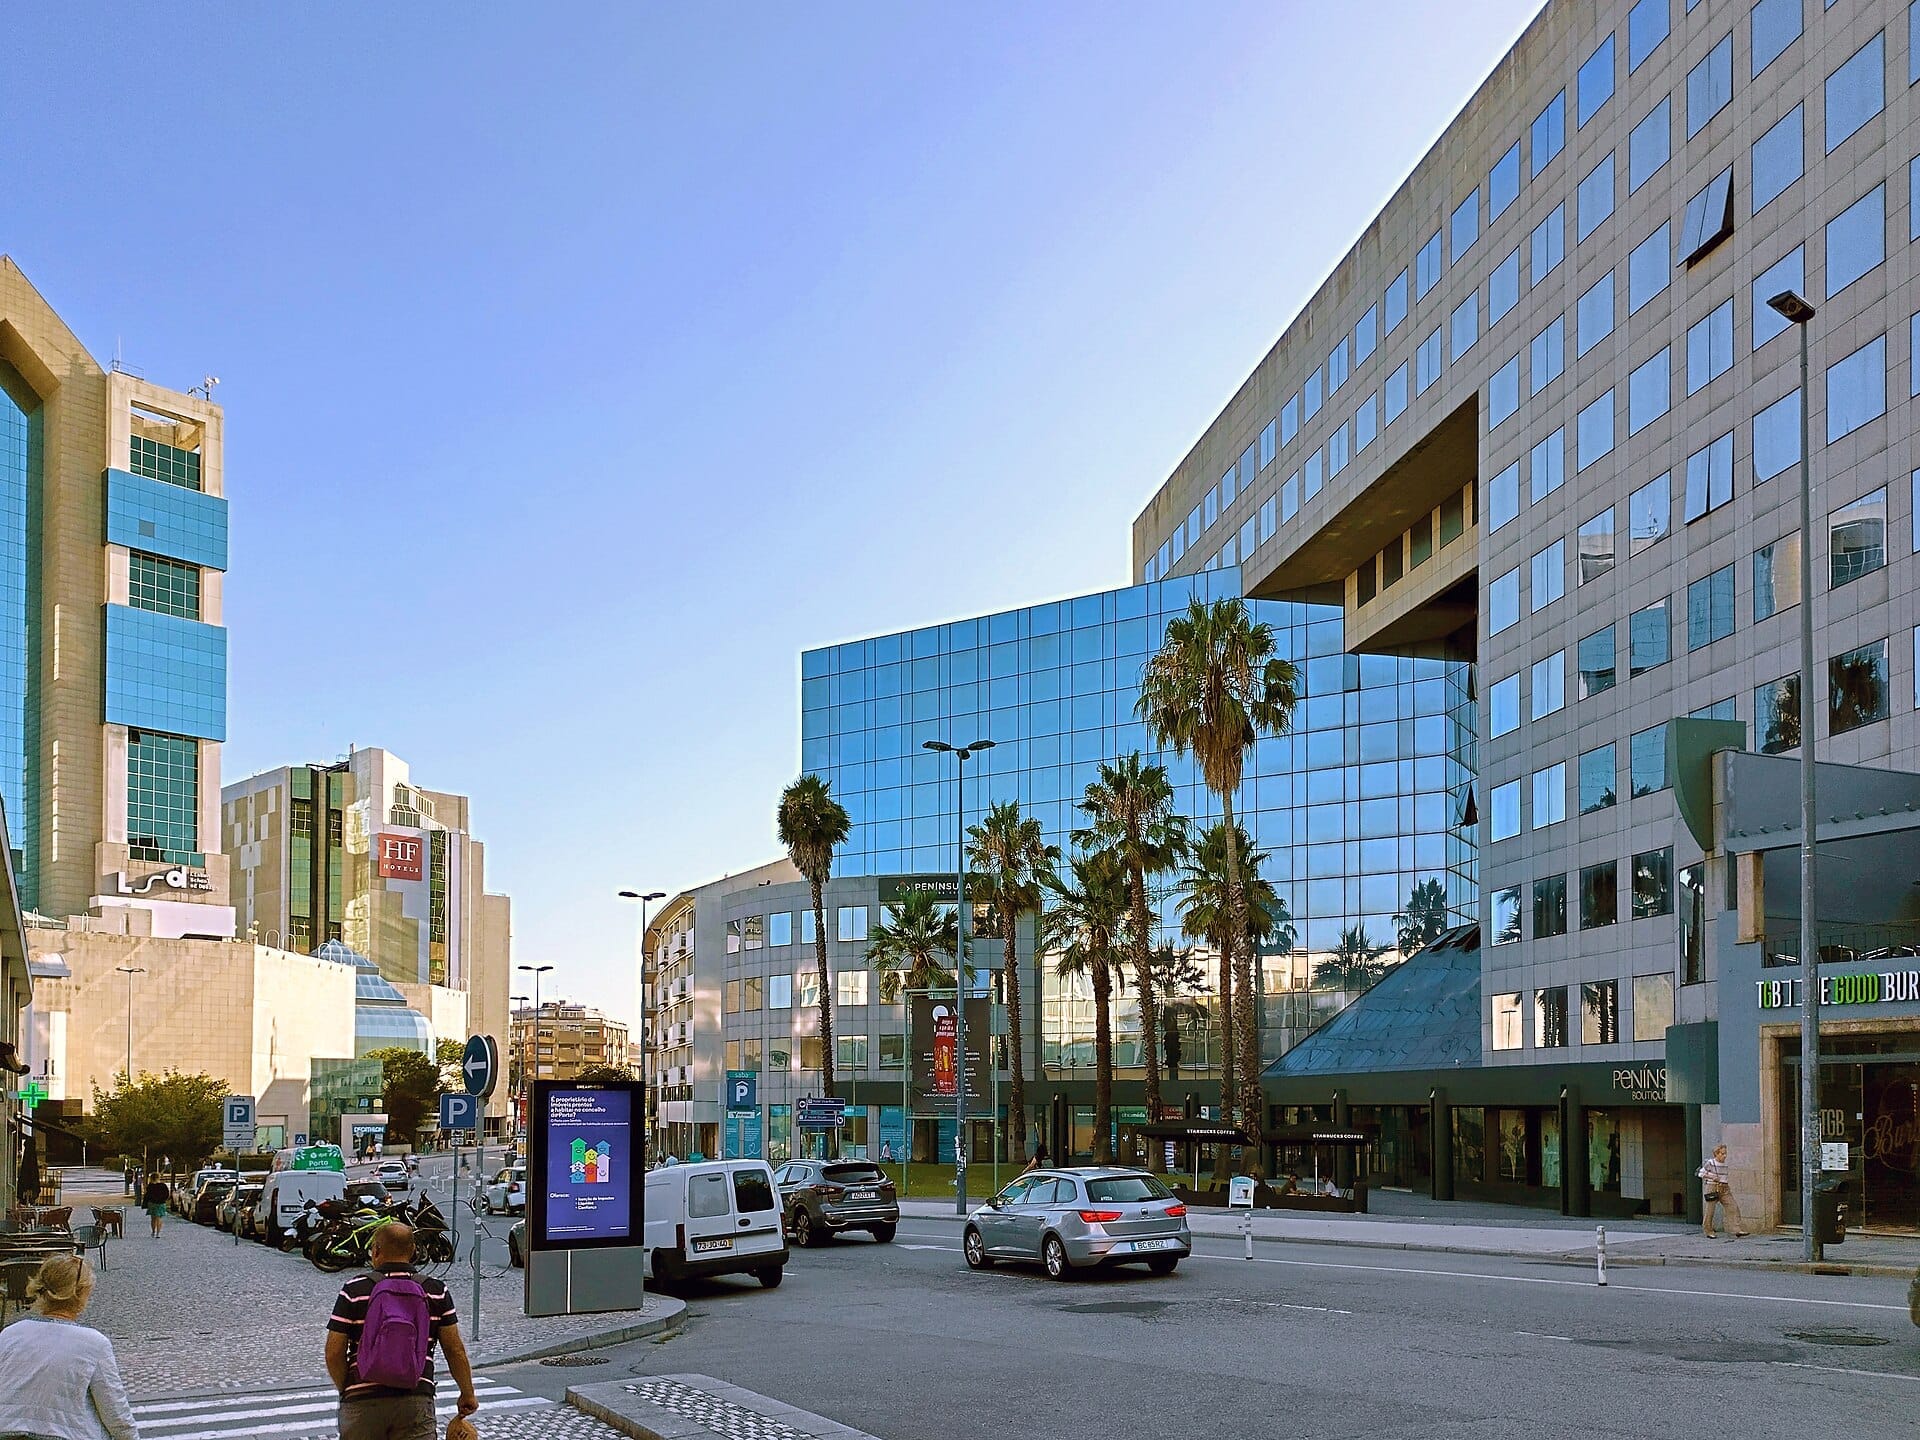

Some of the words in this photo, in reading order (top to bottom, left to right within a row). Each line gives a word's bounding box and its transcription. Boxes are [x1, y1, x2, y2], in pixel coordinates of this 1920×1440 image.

[383, 839, 419, 861] HF
[383, 863, 419, 873] HOTELS
[914, 880, 973, 891] PENÍNSUA
[1755, 980, 1782, 1009] TGB
[1834, 973, 1879, 1005] GOOD
[735, 1085, 748, 1102] P
[233, 1106, 246, 1121] P
[448, 1098, 468, 1125] P
[1820, 1108, 1845, 1137] TGB
[308, 1159, 329, 1168] Porto
